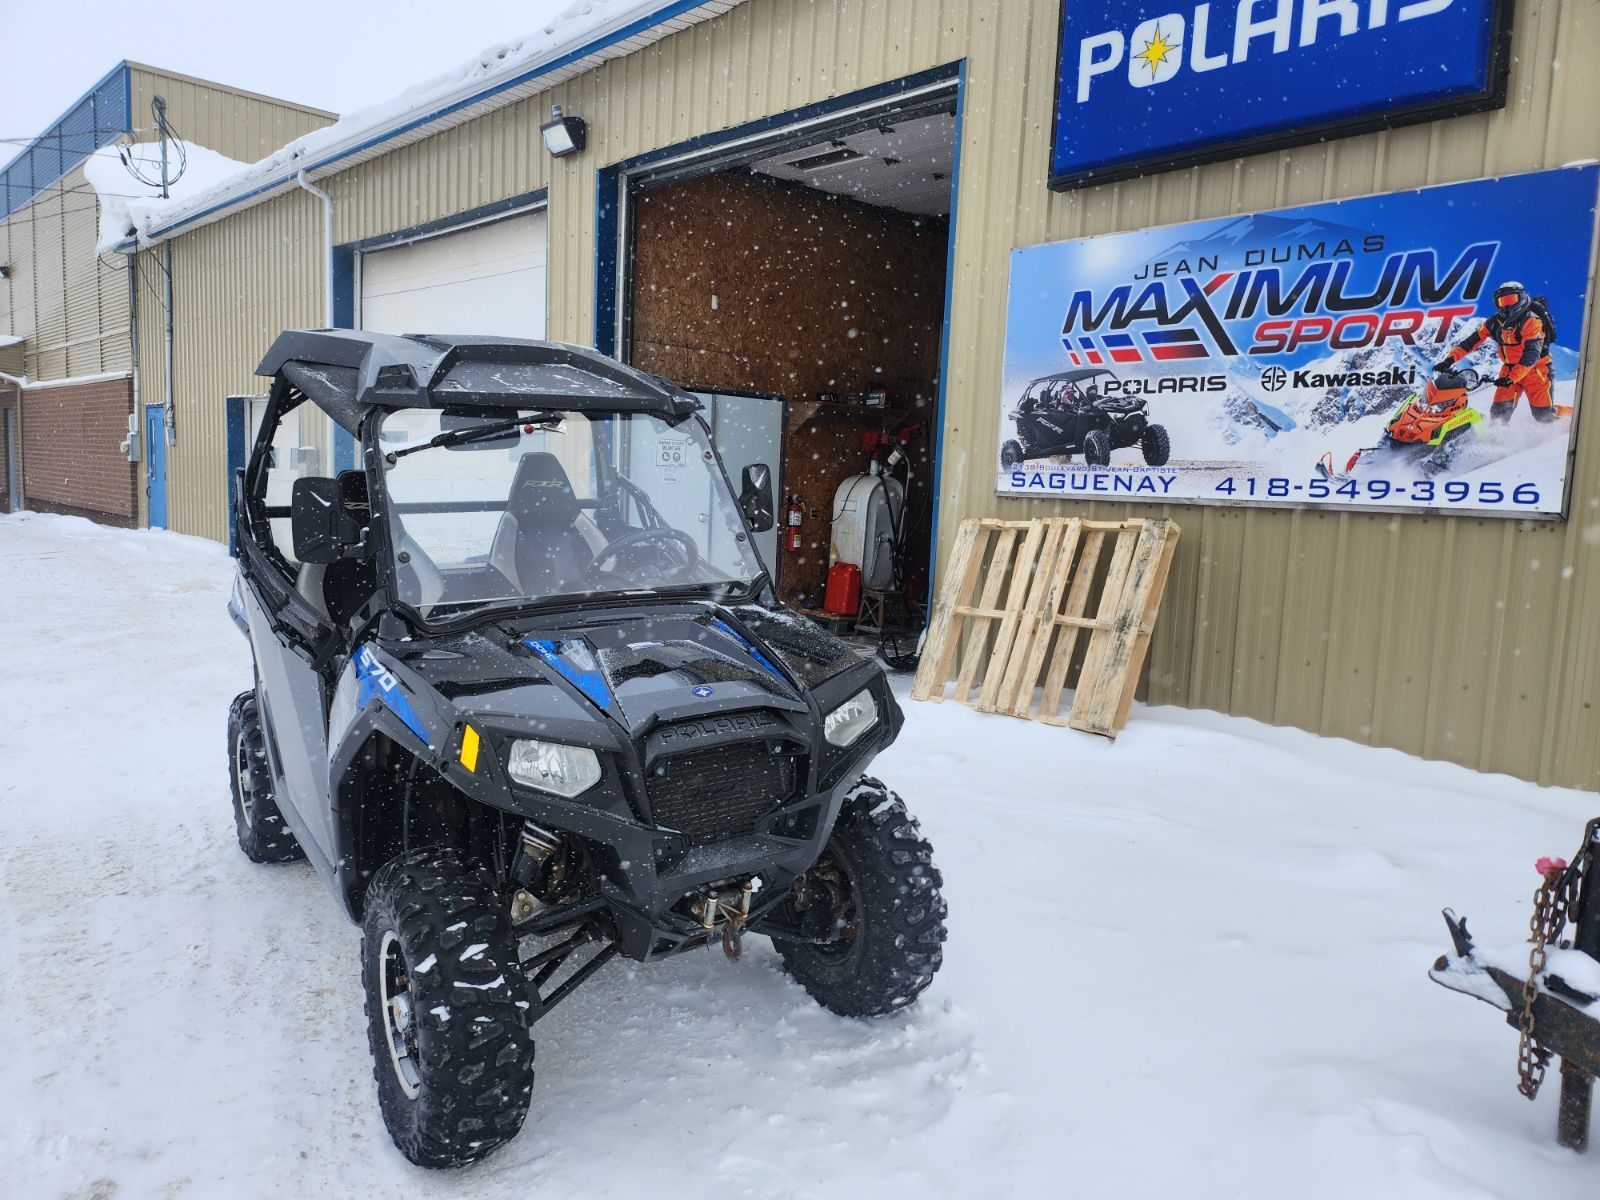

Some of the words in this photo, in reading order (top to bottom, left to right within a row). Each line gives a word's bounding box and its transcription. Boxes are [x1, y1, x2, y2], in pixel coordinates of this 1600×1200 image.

[1134, 254, 1219, 280] JEAN
[1244, 234, 1385, 267] DUMAS
[1062, 243, 1498, 356] MAXIMUM
[1248, 305, 1475, 355] SPORT
[1103, 375, 1227, 396] POLARIS
[1292, 366, 1416, 389] Kawasaki
[1011, 472, 1177, 493] SAGUENAY
[1215, 477, 1541, 505] 418-549-3956
[360, 647, 397, 693] 570
[658, 714, 775, 745] POLARIS
